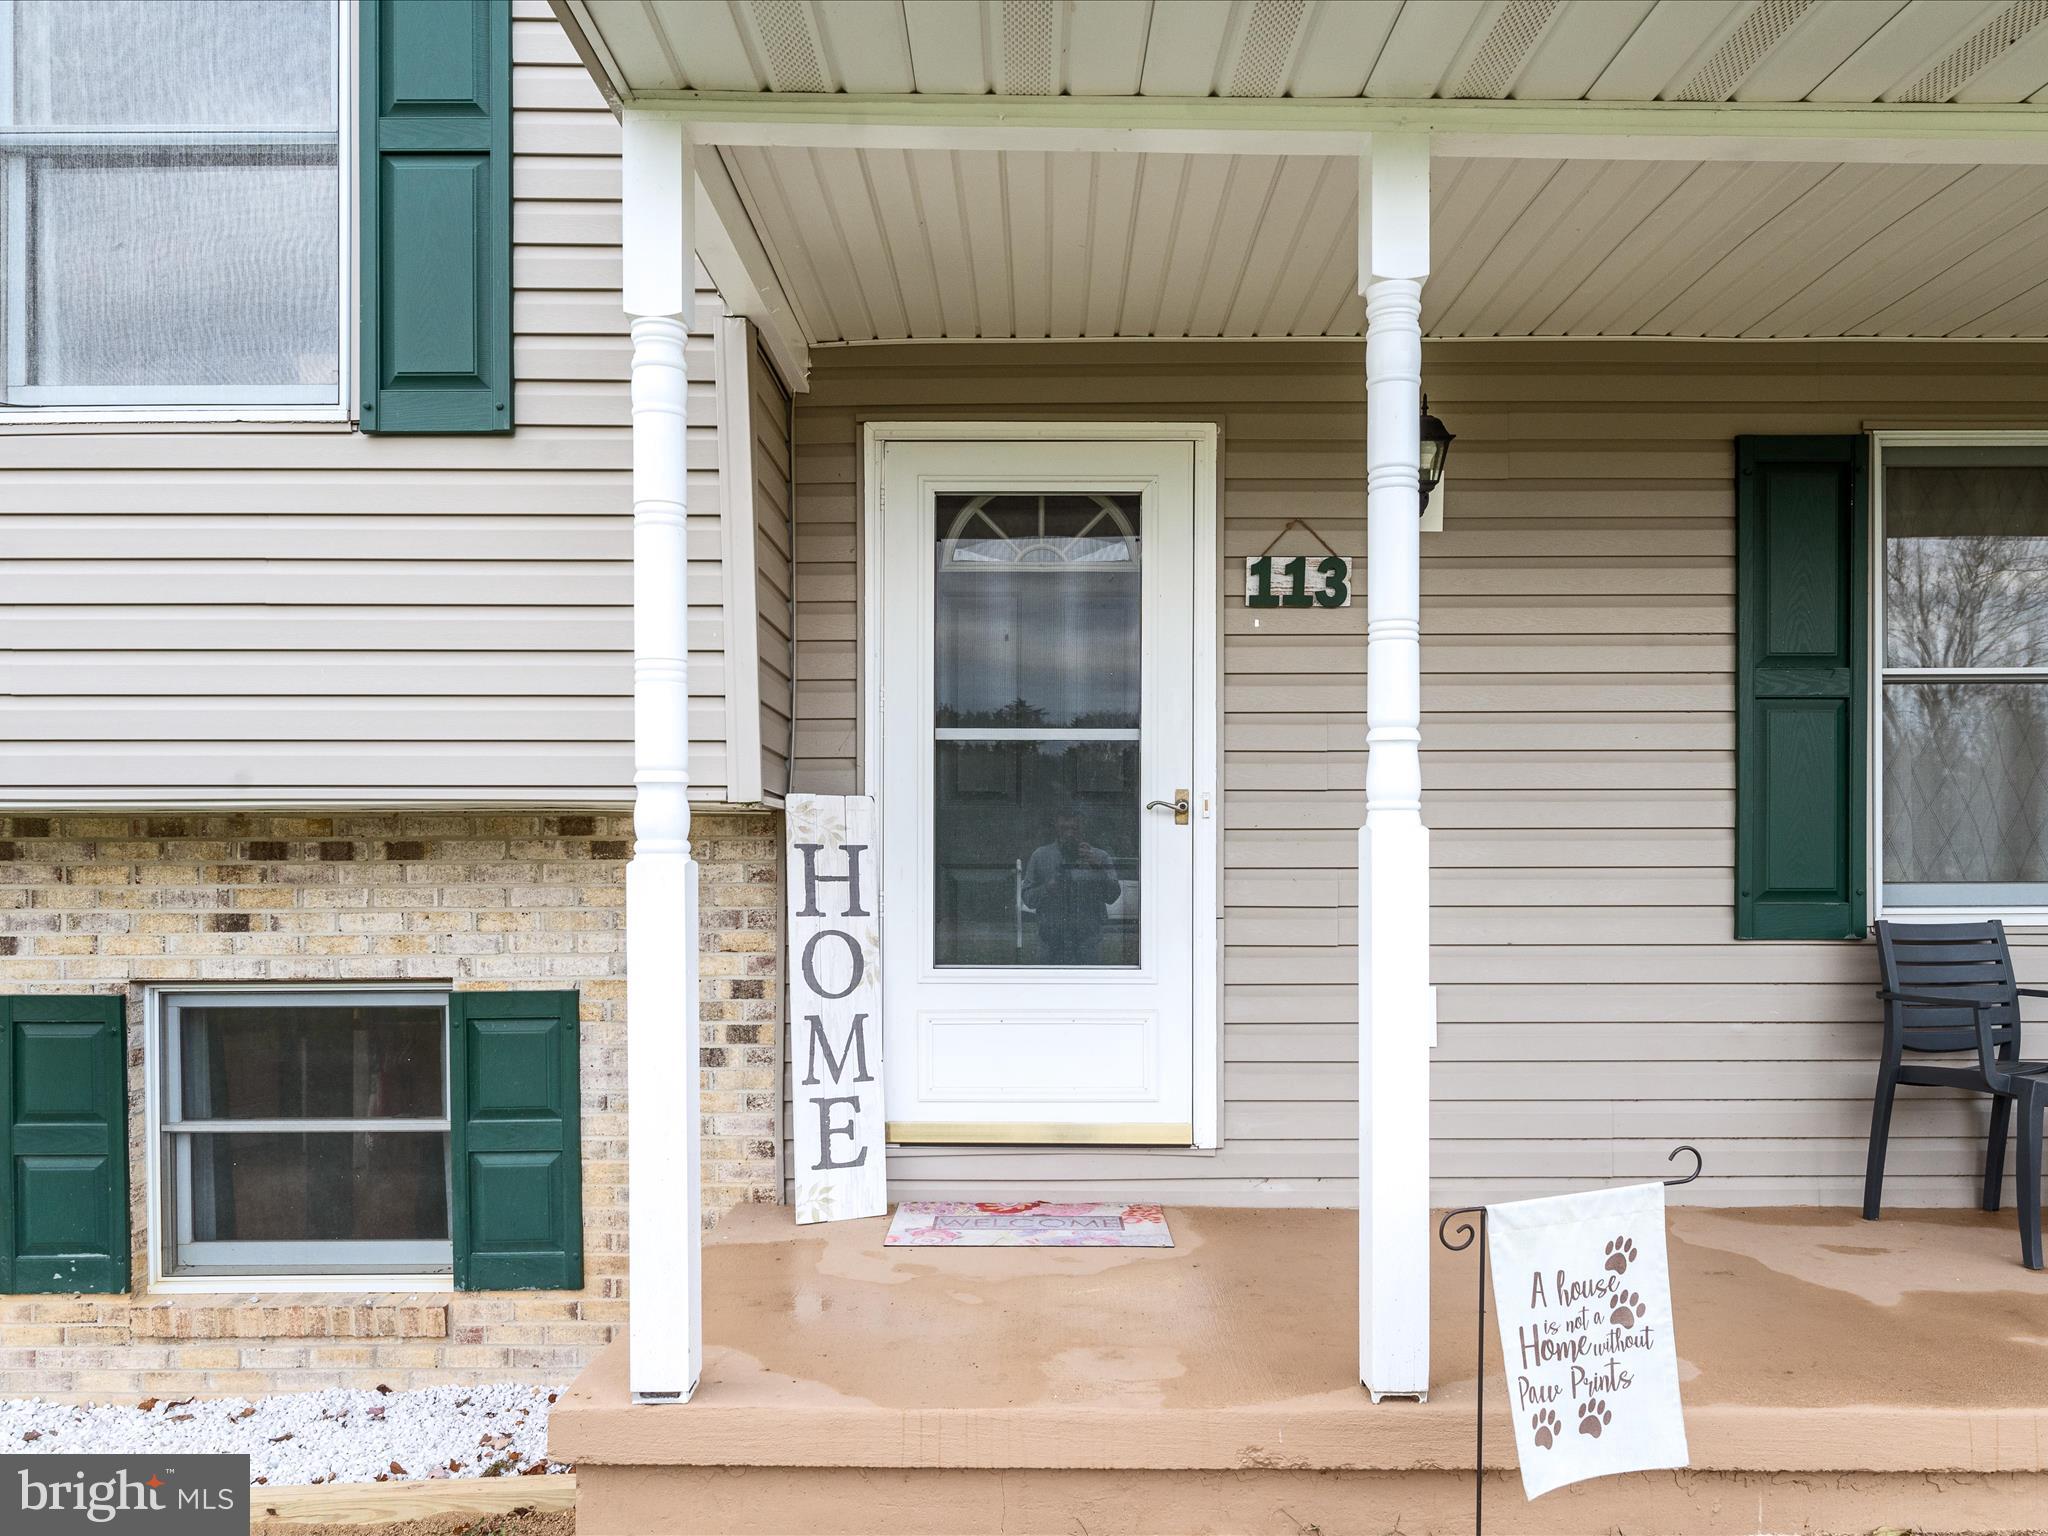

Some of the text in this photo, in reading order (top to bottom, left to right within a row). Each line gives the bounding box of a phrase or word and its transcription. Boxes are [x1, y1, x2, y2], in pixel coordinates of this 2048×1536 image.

[1249, 556, 1348, 608] 113
[793, 843, 874, 1170] HOME
[940, 1218, 1120, 1228] WELCOME
[1531, 1269, 1620, 1309] A house
[1544, 1306, 1605, 1335] is not a
[1519, 1323, 1655, 1370] Home without
[1518, 1357, 1635, 1412] Paw Prints
